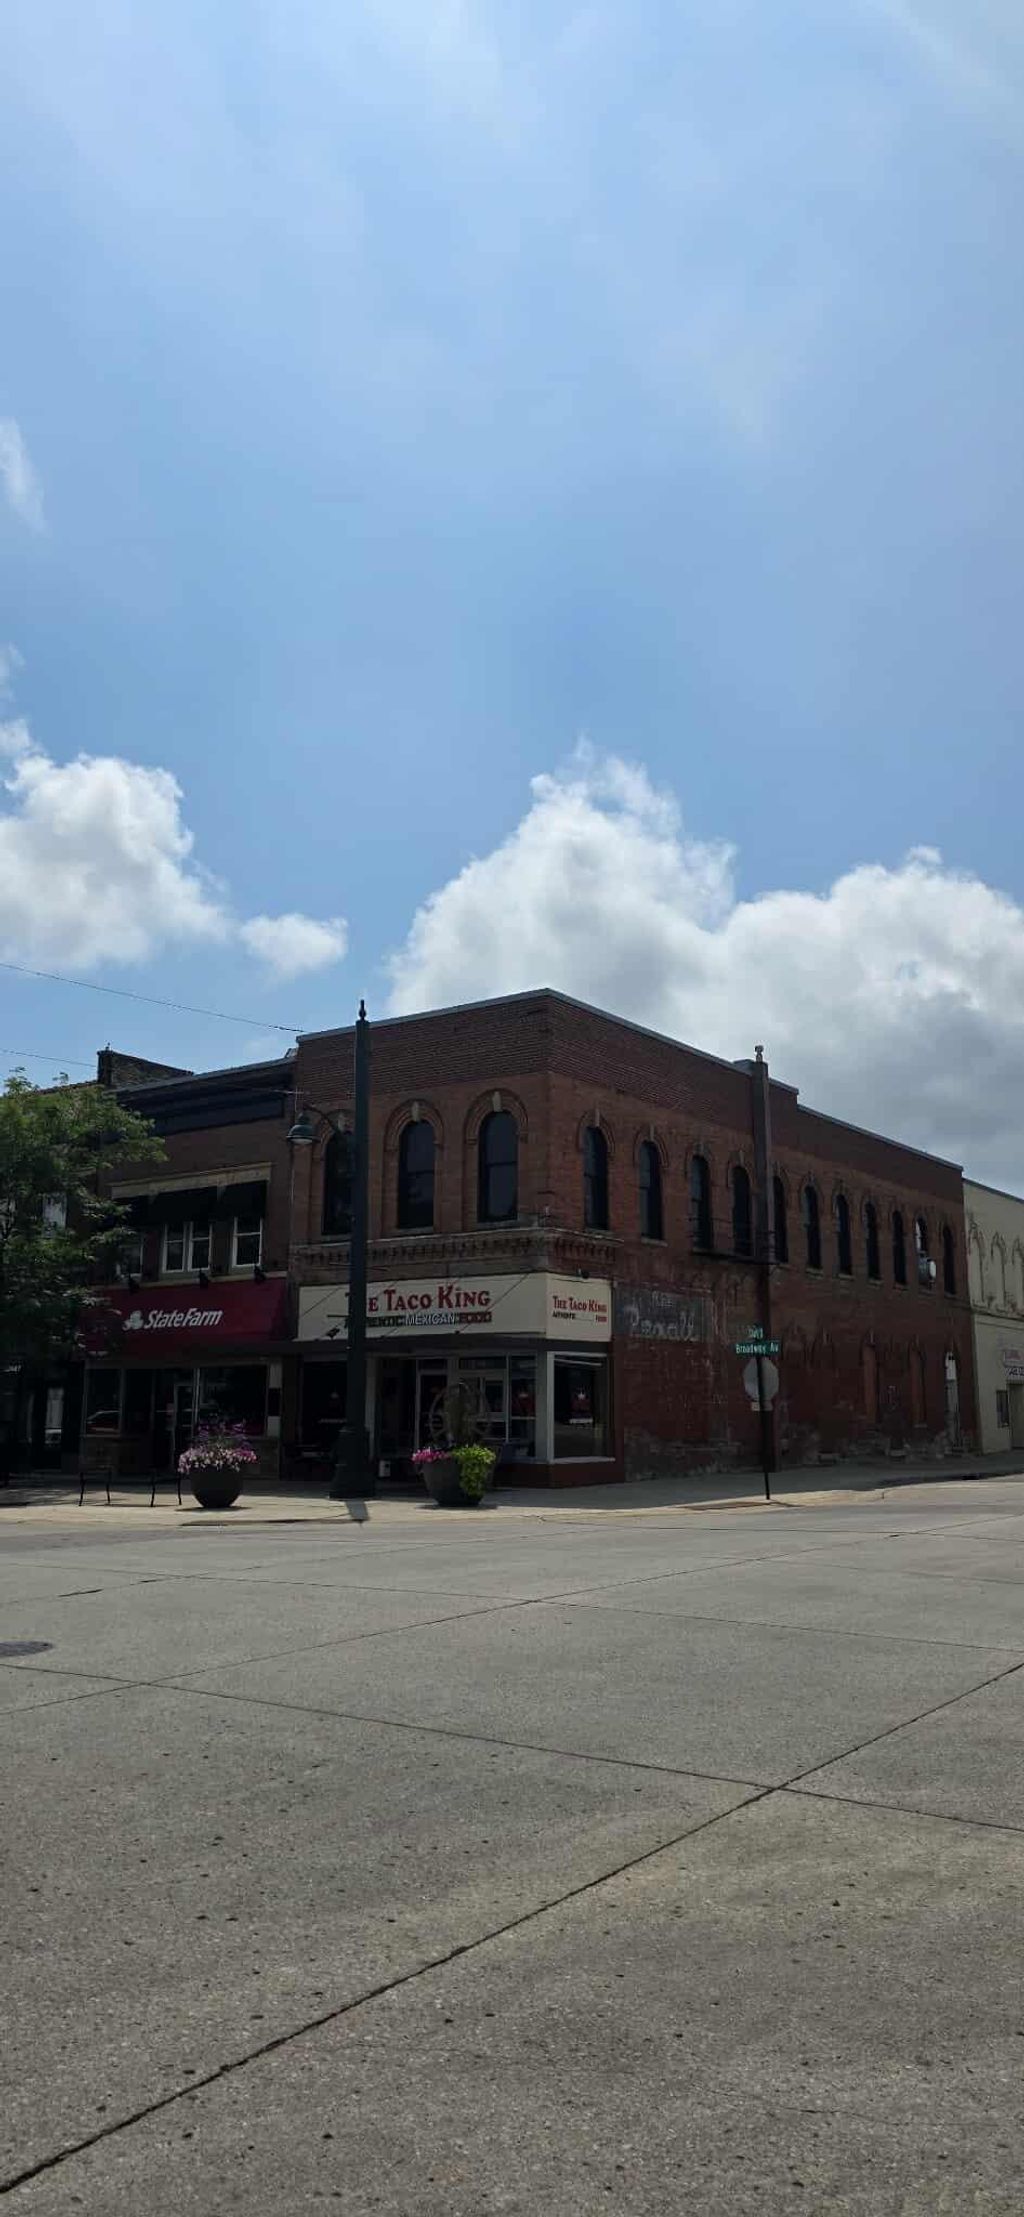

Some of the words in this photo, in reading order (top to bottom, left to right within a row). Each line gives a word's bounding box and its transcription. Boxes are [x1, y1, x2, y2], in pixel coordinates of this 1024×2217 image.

[383, 1289, 432, 1312] TACO
[437, 1284, 490, 1309] KING
[552, 1295, 567, 1309] THE
[405, 1312, 456, 1326] MEXICAN
